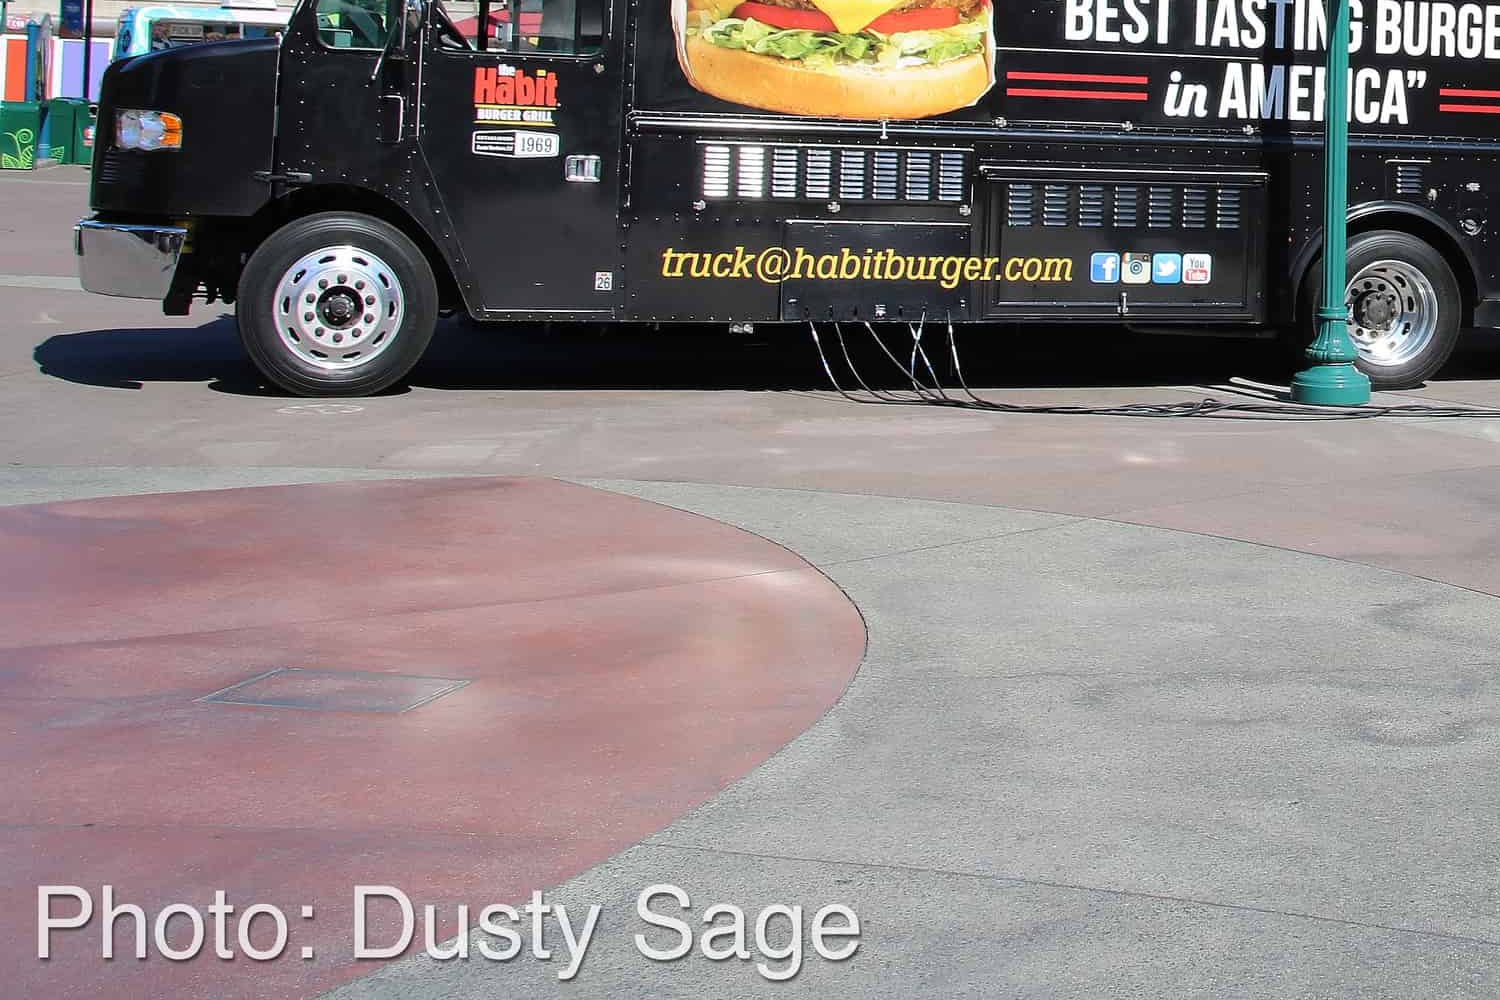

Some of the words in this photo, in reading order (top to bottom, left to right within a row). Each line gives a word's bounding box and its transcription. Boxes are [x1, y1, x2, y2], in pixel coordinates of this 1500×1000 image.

[498, 64, 516, 76] the
[474, 67, 559, 107] Habit
[1162, 70, 1209, 118] in
[477, 108, 522, 122] BURGER
[522, 110, 554, 123] GRILL
[520, 137, 552, 153] 1969
[661, 246, 1073, 289] truck@habitburger.com
[1189, 257, 1205, 269] You
[596, 276, 611, 289] 26
